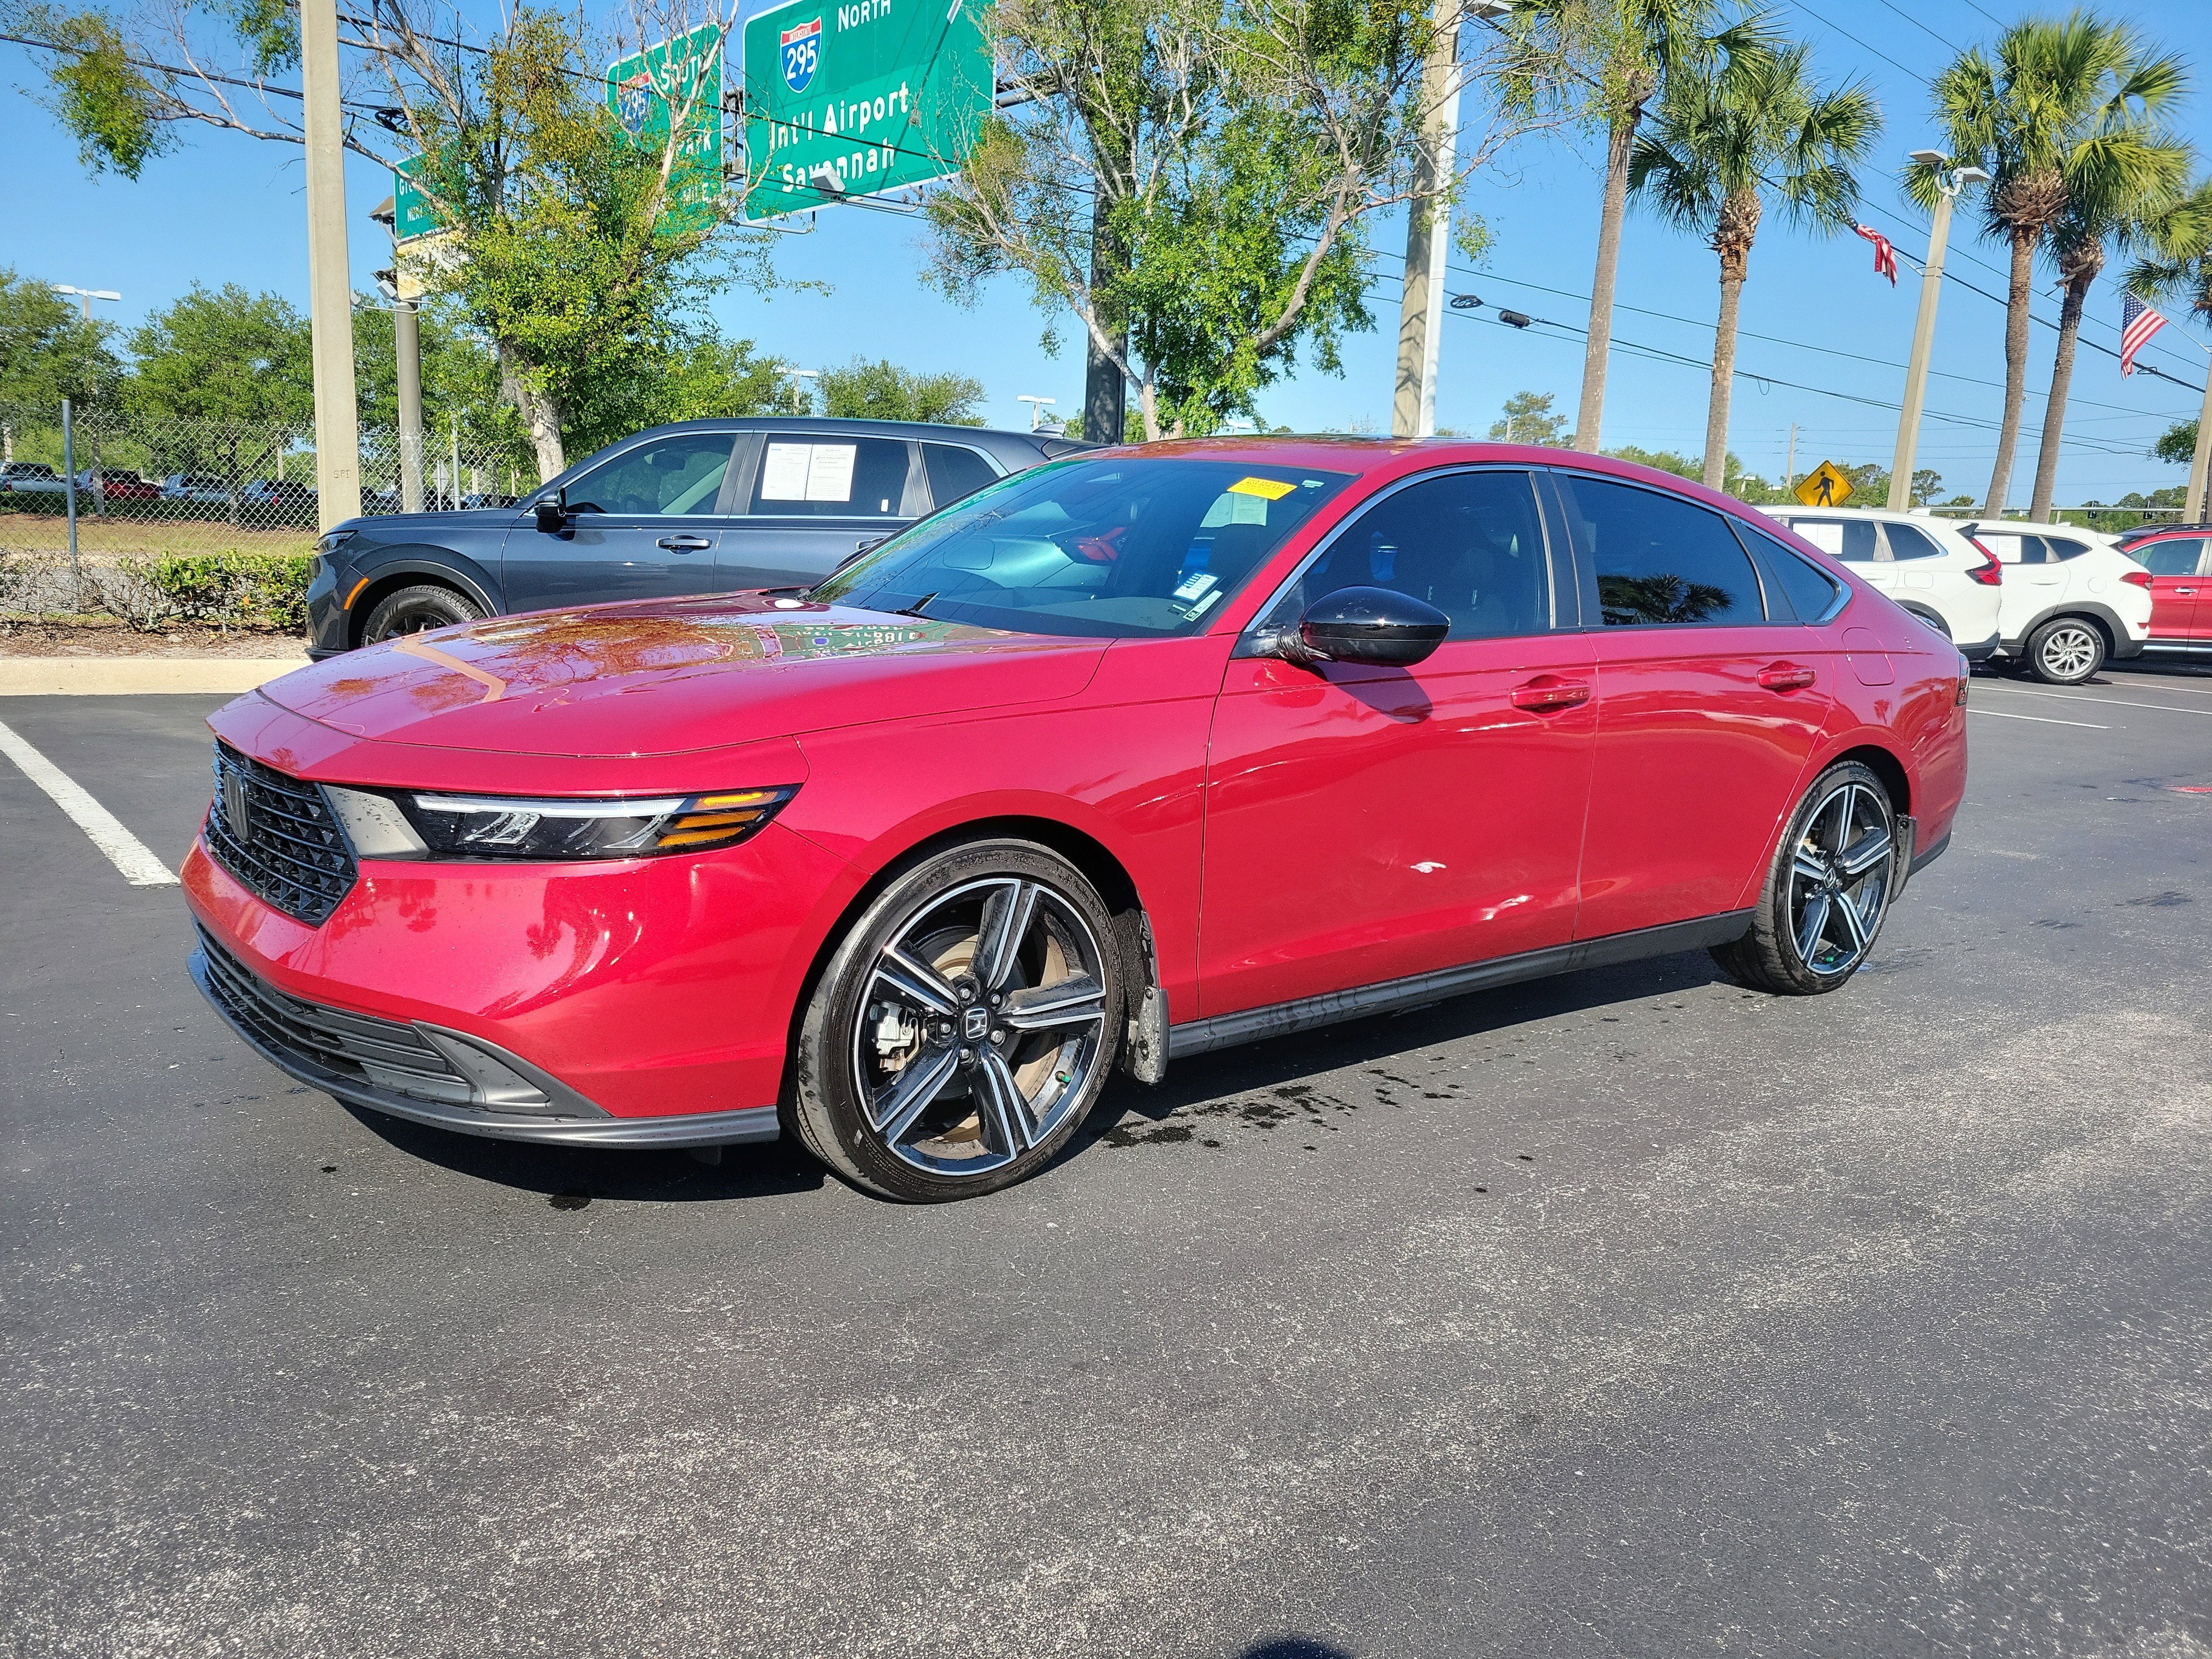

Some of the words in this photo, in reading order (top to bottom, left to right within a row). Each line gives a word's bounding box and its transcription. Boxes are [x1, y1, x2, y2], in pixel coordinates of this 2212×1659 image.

[838, 0, 891, 33] NORTH
[789, 25, 812, 42] INTERSTATE
[787, 39, 817, 81] 295
[769, 110, 812, 152] Int'l
[822, 80, 909, 137] Airport
[333, 469, 351, 479] SPI
